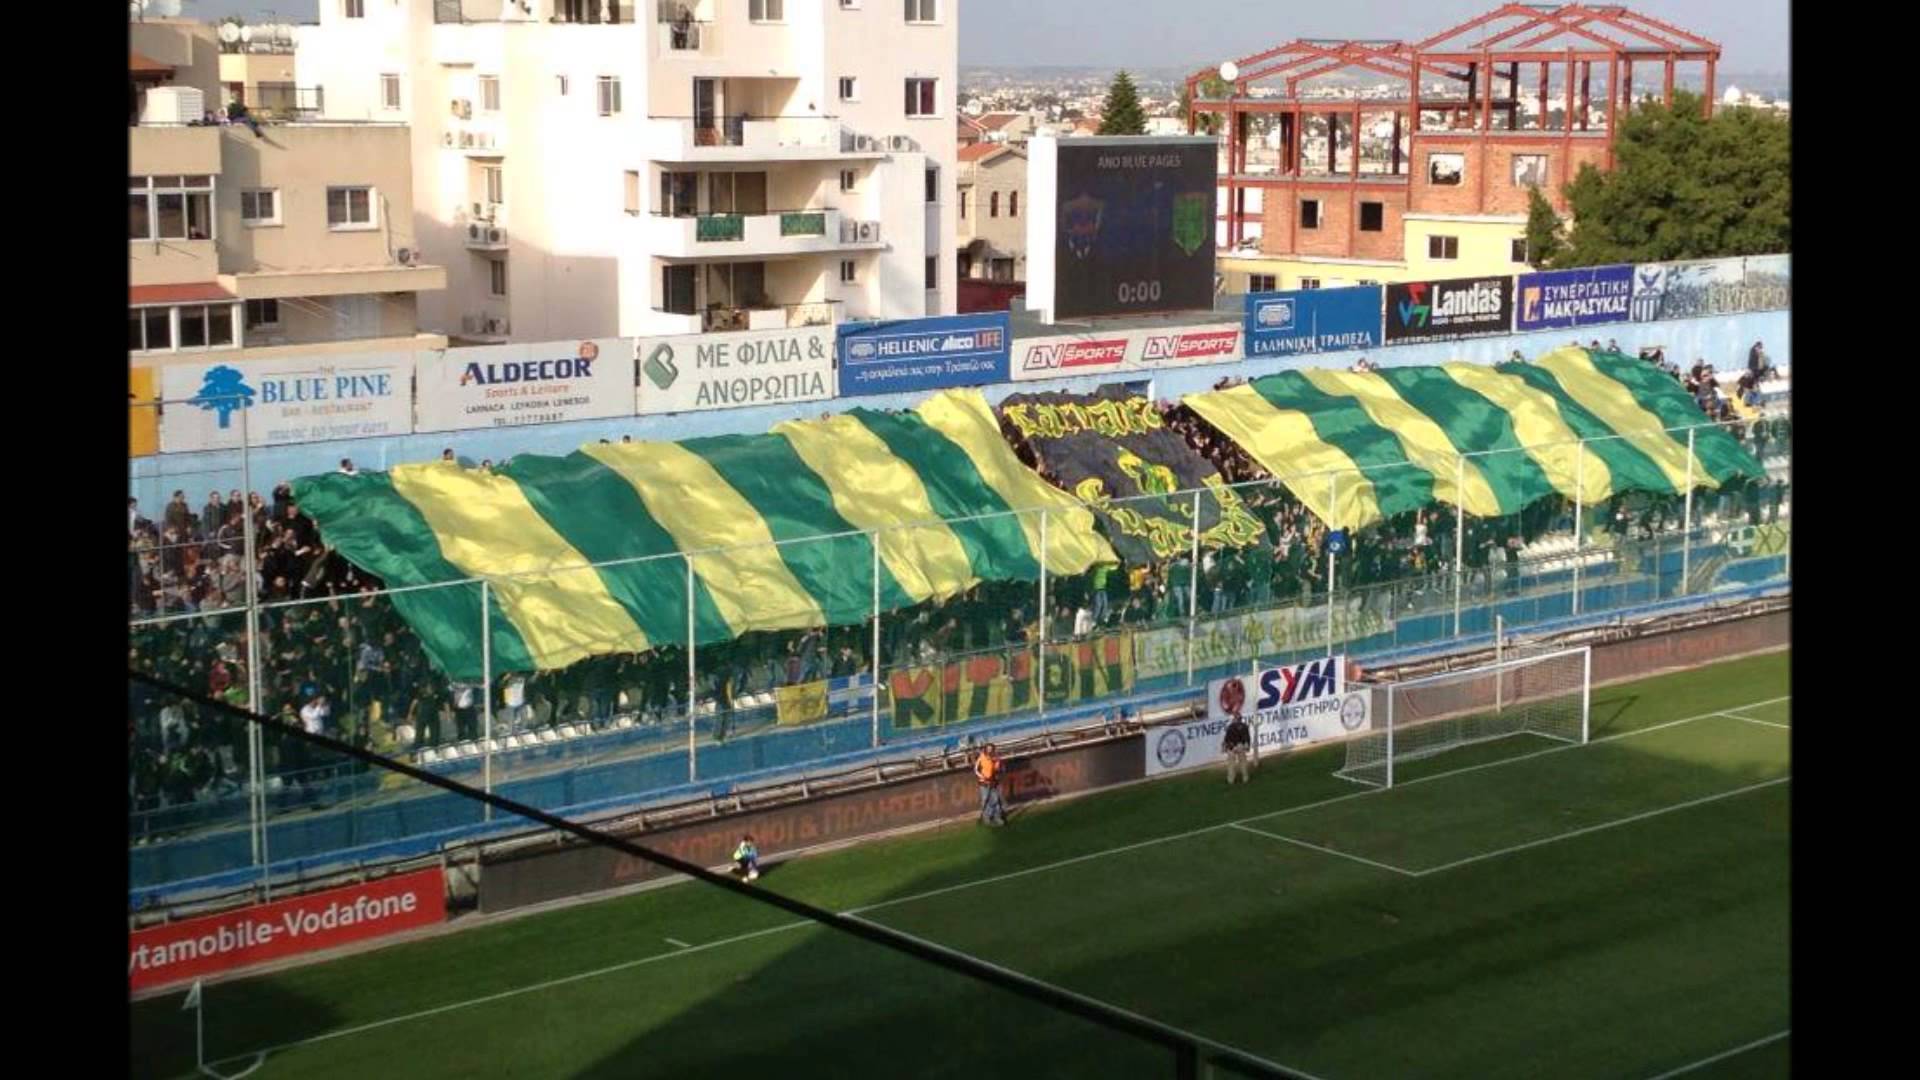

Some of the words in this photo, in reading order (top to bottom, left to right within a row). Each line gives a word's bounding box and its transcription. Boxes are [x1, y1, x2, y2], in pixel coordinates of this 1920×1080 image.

[1122, 154, 1147, 168] BLUE
[1148, 153, 1182, 168] PAGES
[1118, 280, 1161, 303] 0:00
[1432, 282, 1502, 316] Landas
[1544, 281, 1629, 301] ΣΥΝΕΡΓΑΤΙΚΗ
[1544, 296, 1628, 319] ΜΑΚΡΑΣΥΚΑΣ
[736, 337, 803, 365] ΦΙΛΙΑ
[808, 335, 825, 359] &
[878, 338, 940, 355] HELLENIC
[976, 331, 1001, 348] LIFE
[1179, 337, 1236, 352] SPORTS
[1320, 331, 1374, 348] ΤΡΑΠΕΖΑ
[1064, 345, 1124, 362] SPORTS
[460, 358, 592, 386] ALDECOR
[261, 378, 329, 404] BLUE
[335, 374, 392, 399] PINE
[696, 371, 826, 406] ΑΝΘΡΩΠΙΑ
[1257, 656, 1337, 710] SYM
